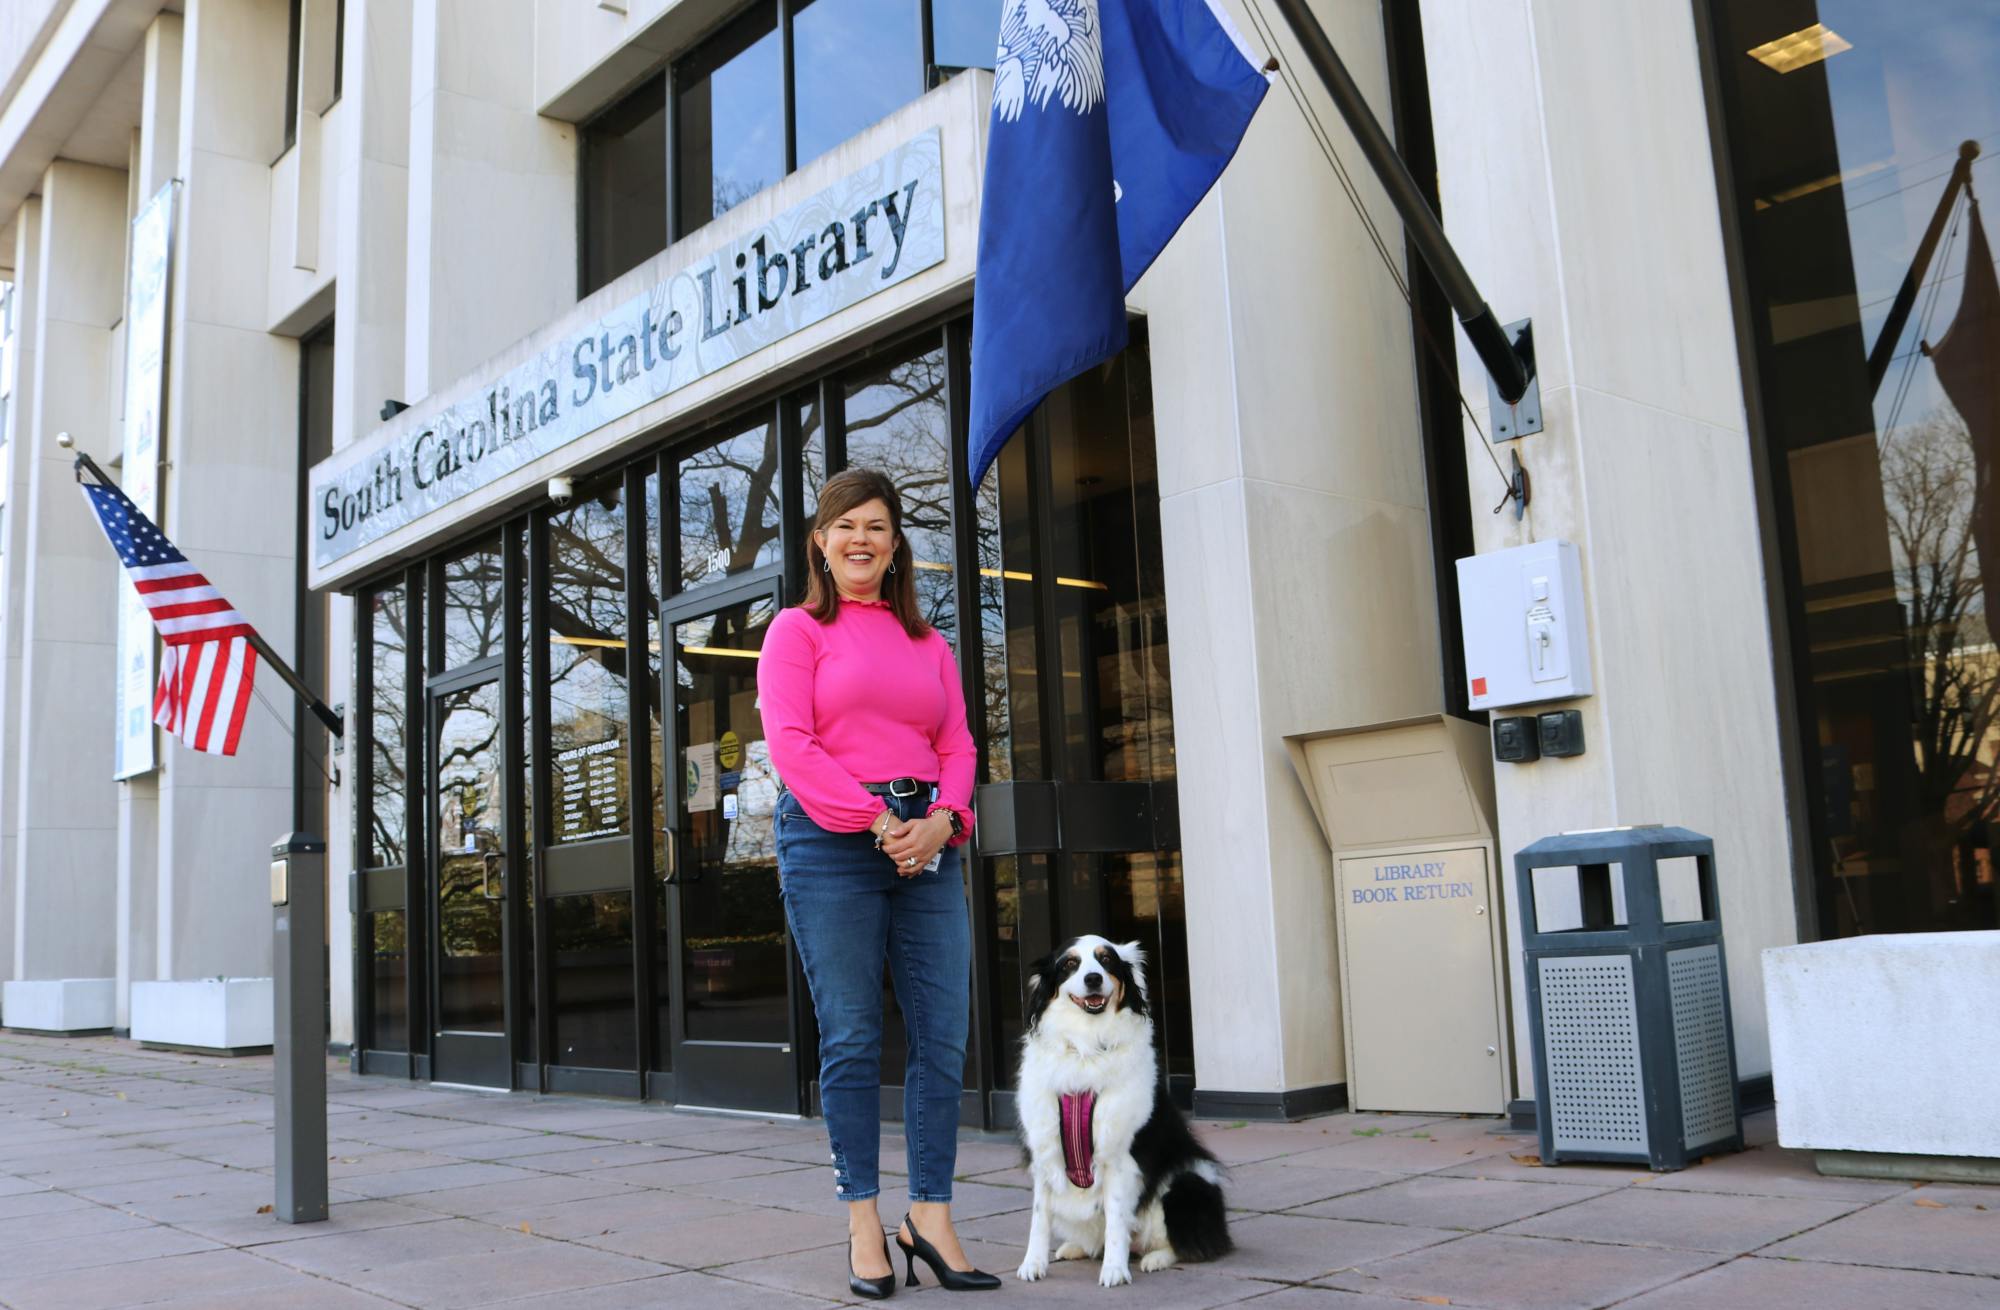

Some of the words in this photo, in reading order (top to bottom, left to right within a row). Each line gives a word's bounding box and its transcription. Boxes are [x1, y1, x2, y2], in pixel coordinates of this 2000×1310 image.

[324, 451, 402, 540] South
[412, 378, 560, 490] Carolina
[572, 307, 683, 407] State
[697, 179, 919, 342] Library
[708, 547, 730, 573] 1500
[578, 747, 587, 757] OF
[1374, 862, 1446, 881] LIBRARY
[1352, 887, 1398, 904] BOOK
[1403, 882, 1473, 901] RETURN
